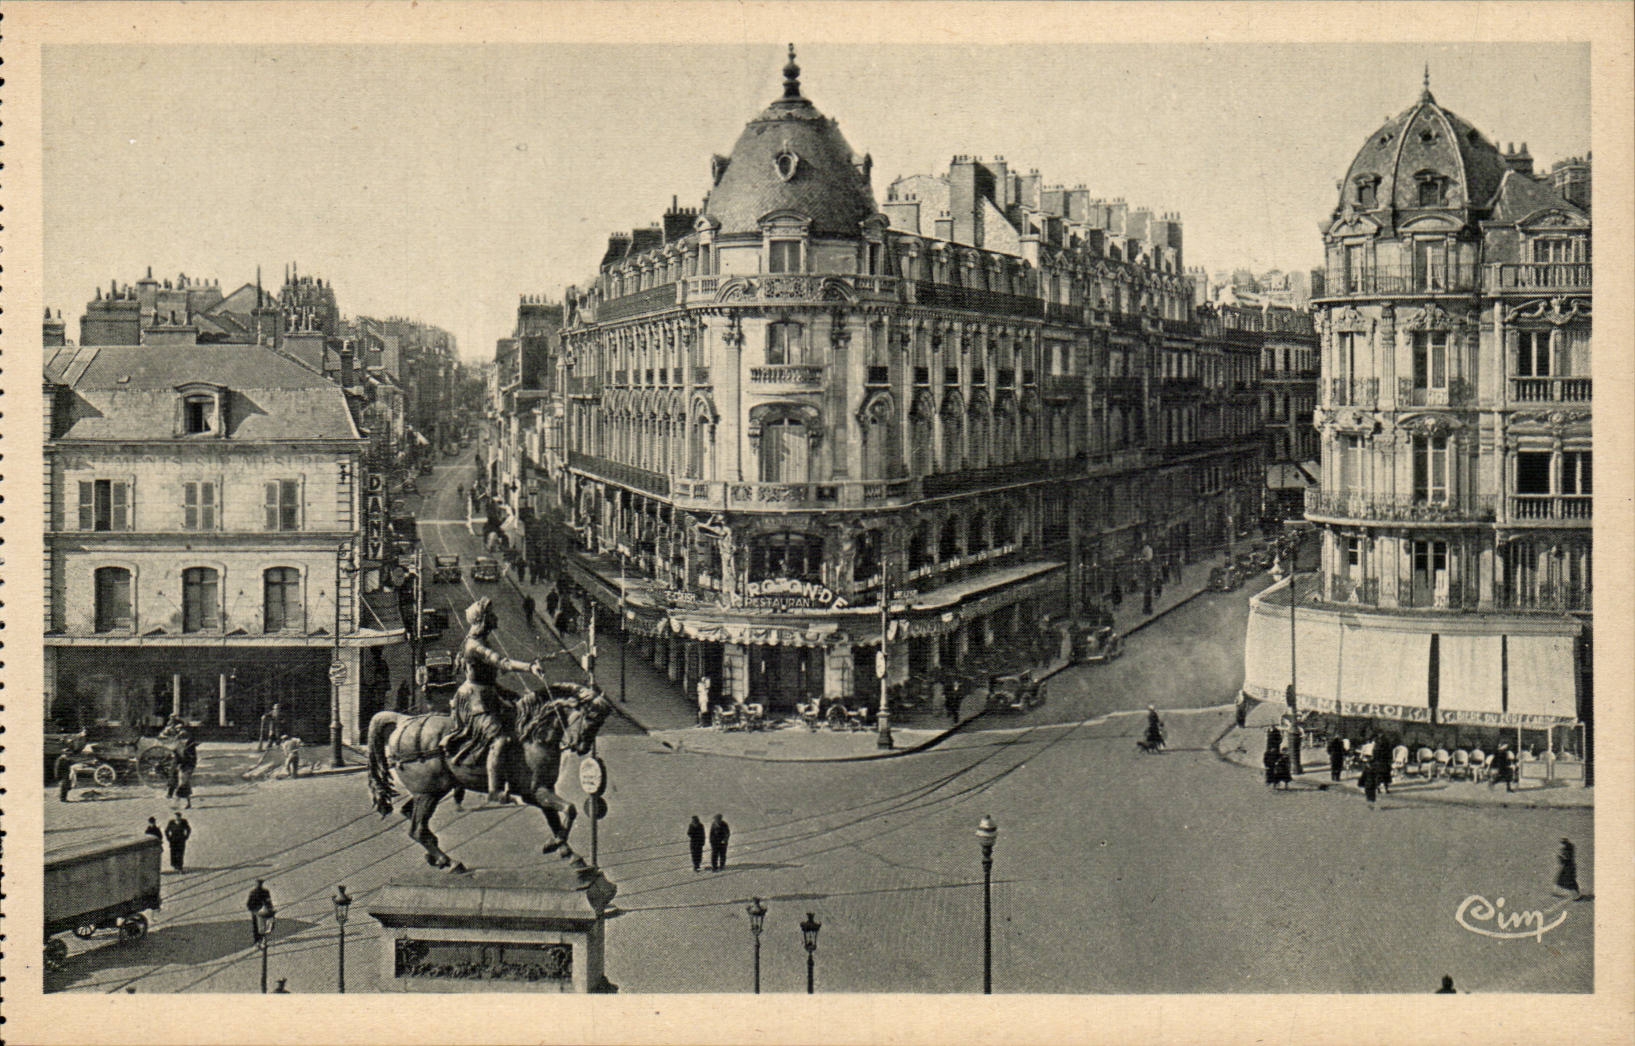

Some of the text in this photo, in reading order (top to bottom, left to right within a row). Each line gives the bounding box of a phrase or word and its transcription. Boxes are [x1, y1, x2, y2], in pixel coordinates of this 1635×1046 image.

[195, 455, 231, 471] SUR
[242, 455, 326, 471] MESURE
[368, 477, 383, 559] DANY
[717, 578, 849, 612] LA ROTONDE
[744, 598, 816, 608] RESTAURANT
